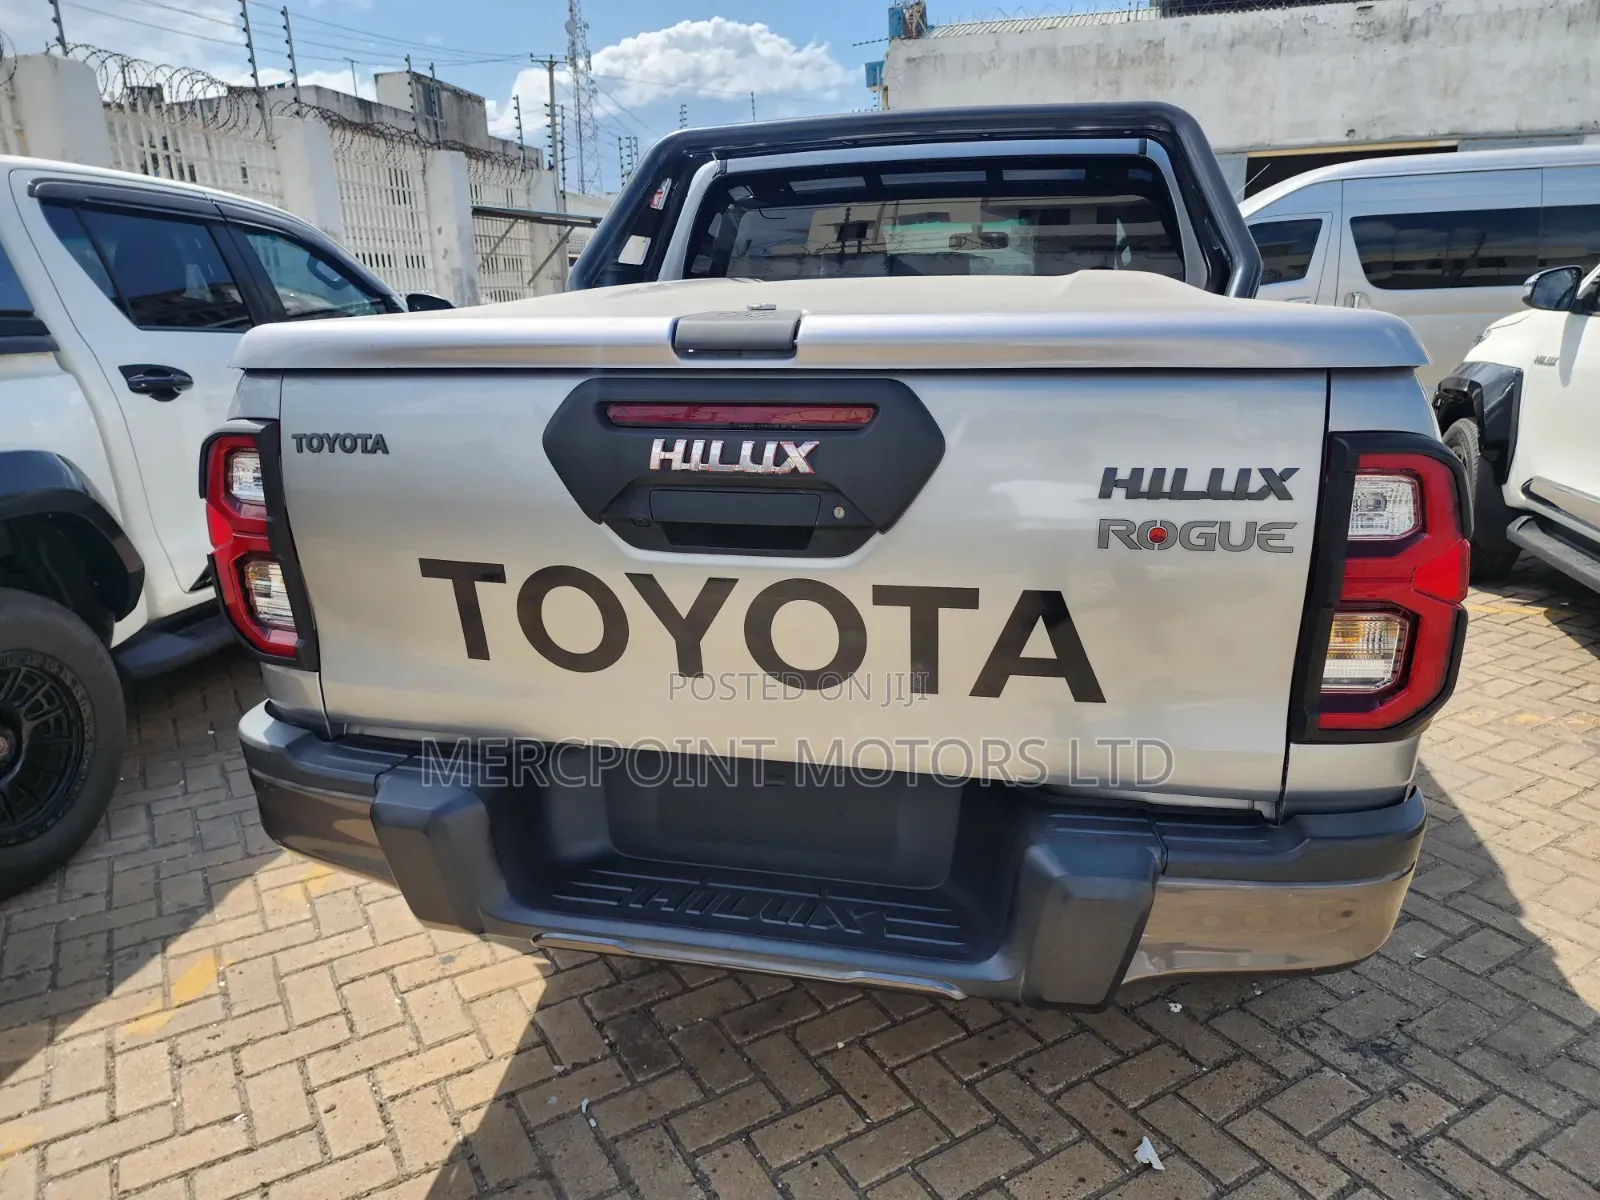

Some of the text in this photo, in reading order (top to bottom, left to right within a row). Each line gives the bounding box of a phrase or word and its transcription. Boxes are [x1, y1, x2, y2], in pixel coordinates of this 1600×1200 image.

[291, 433, 390, 454] TOYOTA
[650, 438, 819, 474] HILUX
[1098, 467, 1300, 500] HILUX
[1097, 518, 1298, 553] ROGUE
[418, 557, 1107, 704] TOYOTA
[622, 879, 876, 934] HILUX
